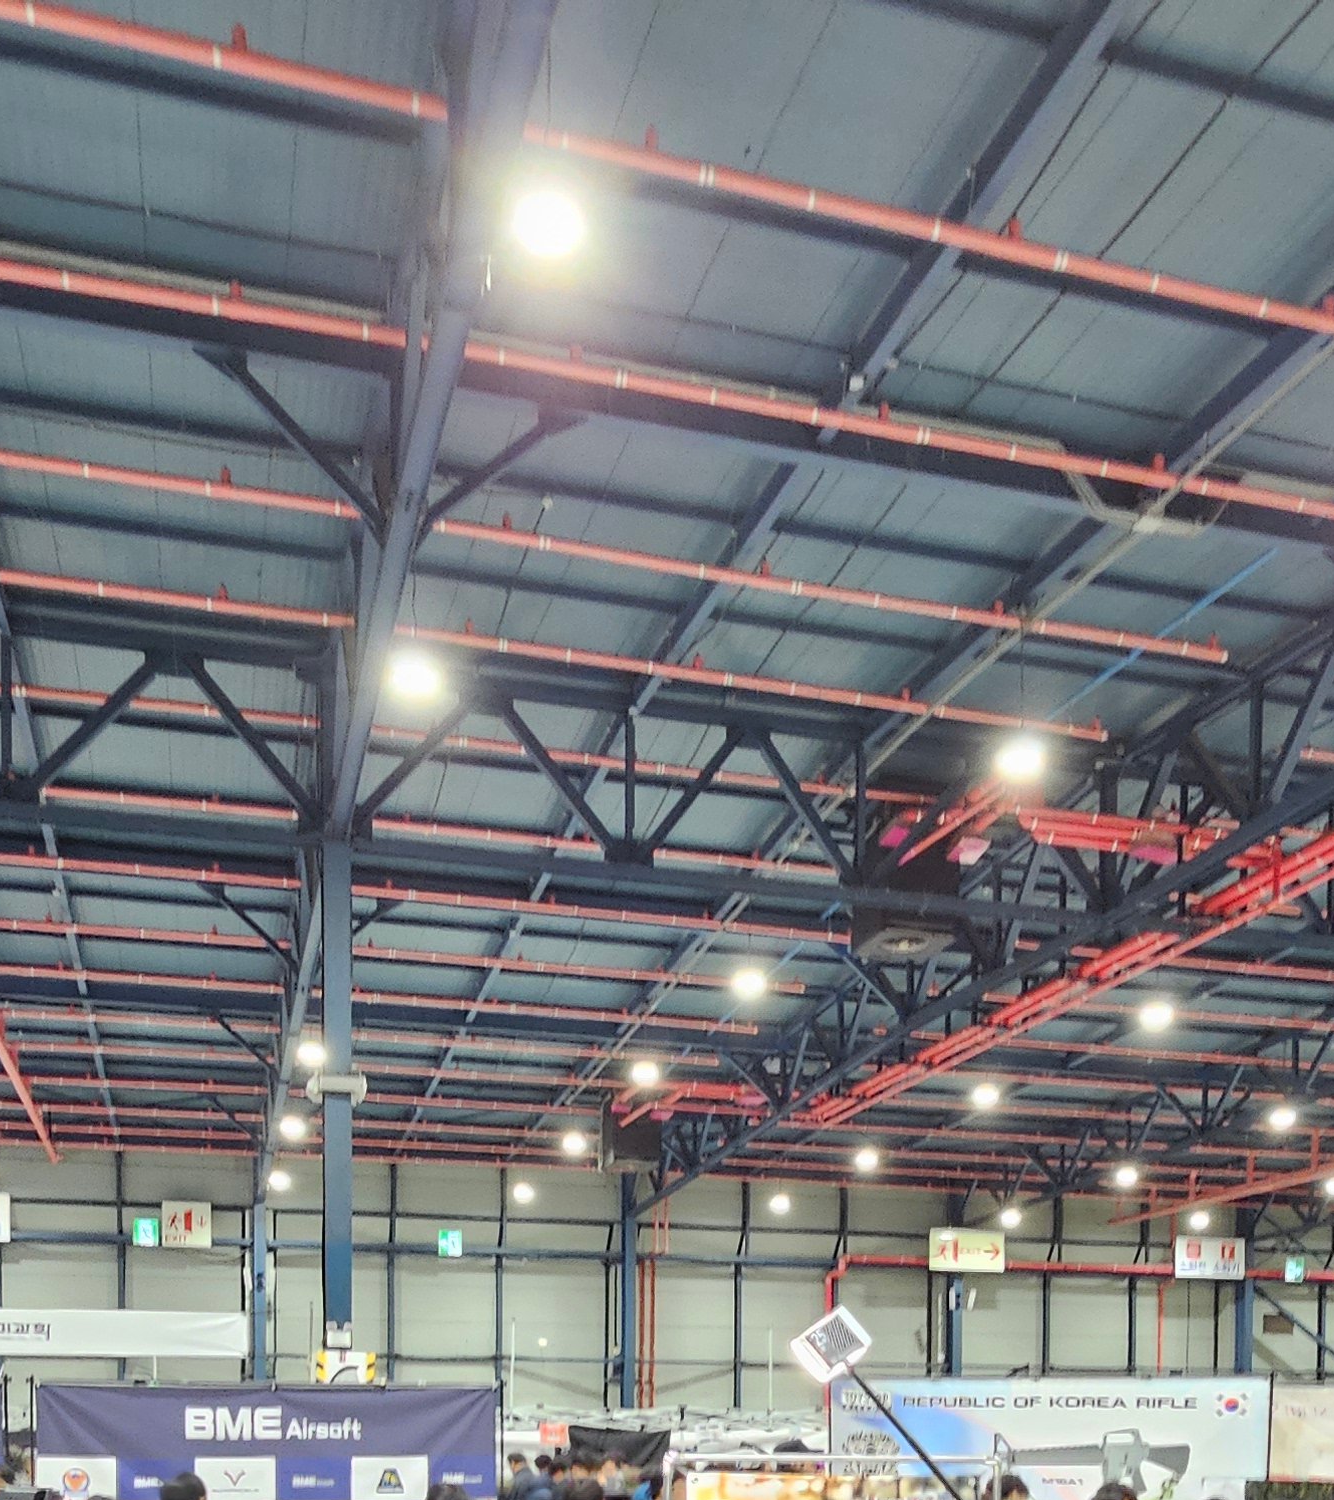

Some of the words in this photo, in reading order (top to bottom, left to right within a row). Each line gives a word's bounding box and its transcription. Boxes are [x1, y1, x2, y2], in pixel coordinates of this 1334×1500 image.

[903, 1396, 1005, 1409] REPUBLIC
[1013, 1396, 1042, 1409] OF
[1049, 1396, 1127, 1408] KOREA
[1136, 1397, 1198, 1409] RIFLE
[185, 1405, 282, 1441] BME
[285, 1416, 362, 1441] Airsoft
